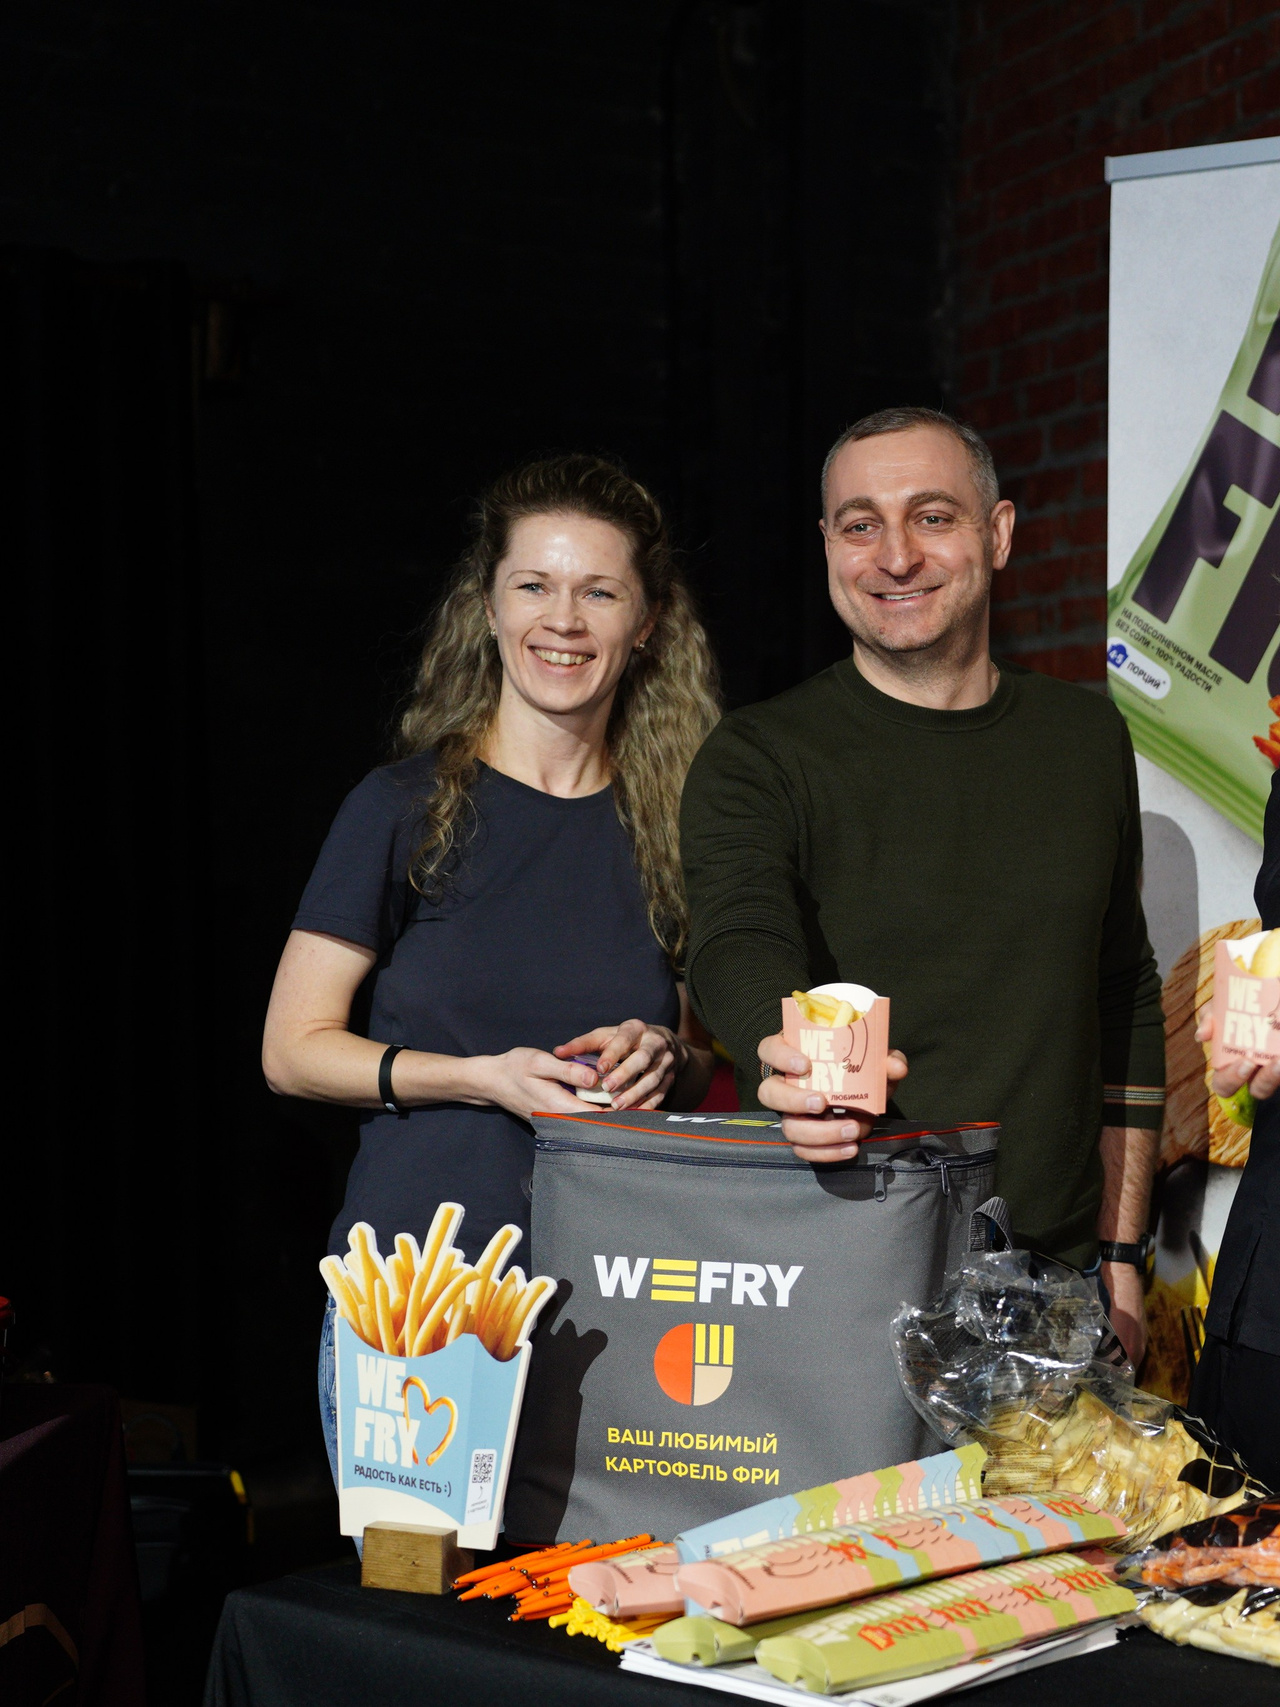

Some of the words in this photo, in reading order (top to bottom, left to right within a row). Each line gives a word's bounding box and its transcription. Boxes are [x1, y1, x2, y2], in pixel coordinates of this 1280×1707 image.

[1115, 618, 1130, 634] БЕЗ
[1129, 628, 1151, 649] СОЛИ
[1155, 646, 1176, 667] 100%
[1175, 662, 1213, 693] РАДОСТИ
[1121, 607, 1133, 620] НА
[1131, 615, 1195, 665] ПОДСОЛНЕЧНОМ
[1194, 661, 1223, 686] МАСЛЕ
[1228, 975, 1263, 1015] WE
[800, 1028, 835, 1061] WE
[1222, 1010, 1271, 1051] FRY
[830, 1092, 869, 1102] ЛЮБИМАЯ
[593, 1254, 804, 1307] WEFRY
[356, 1353, 407, 1413] WE
[353, 1406, 421, 1469] FRY
[607, 1427, 654, 1447] ВАШ
[659, 1431, 778, 1455] ЛЮБИМЫЙ
[354, 1464, 396, 1484] РАДОСТЬ
[398, 1474, 417, 1489] КАК
[419, 1479, 442, 1494] ЕСТЬ
[605, 1456, 728, 1479] КАРТОФЕЛЬ
[732, 1465, 780, 1486] ФРИ
